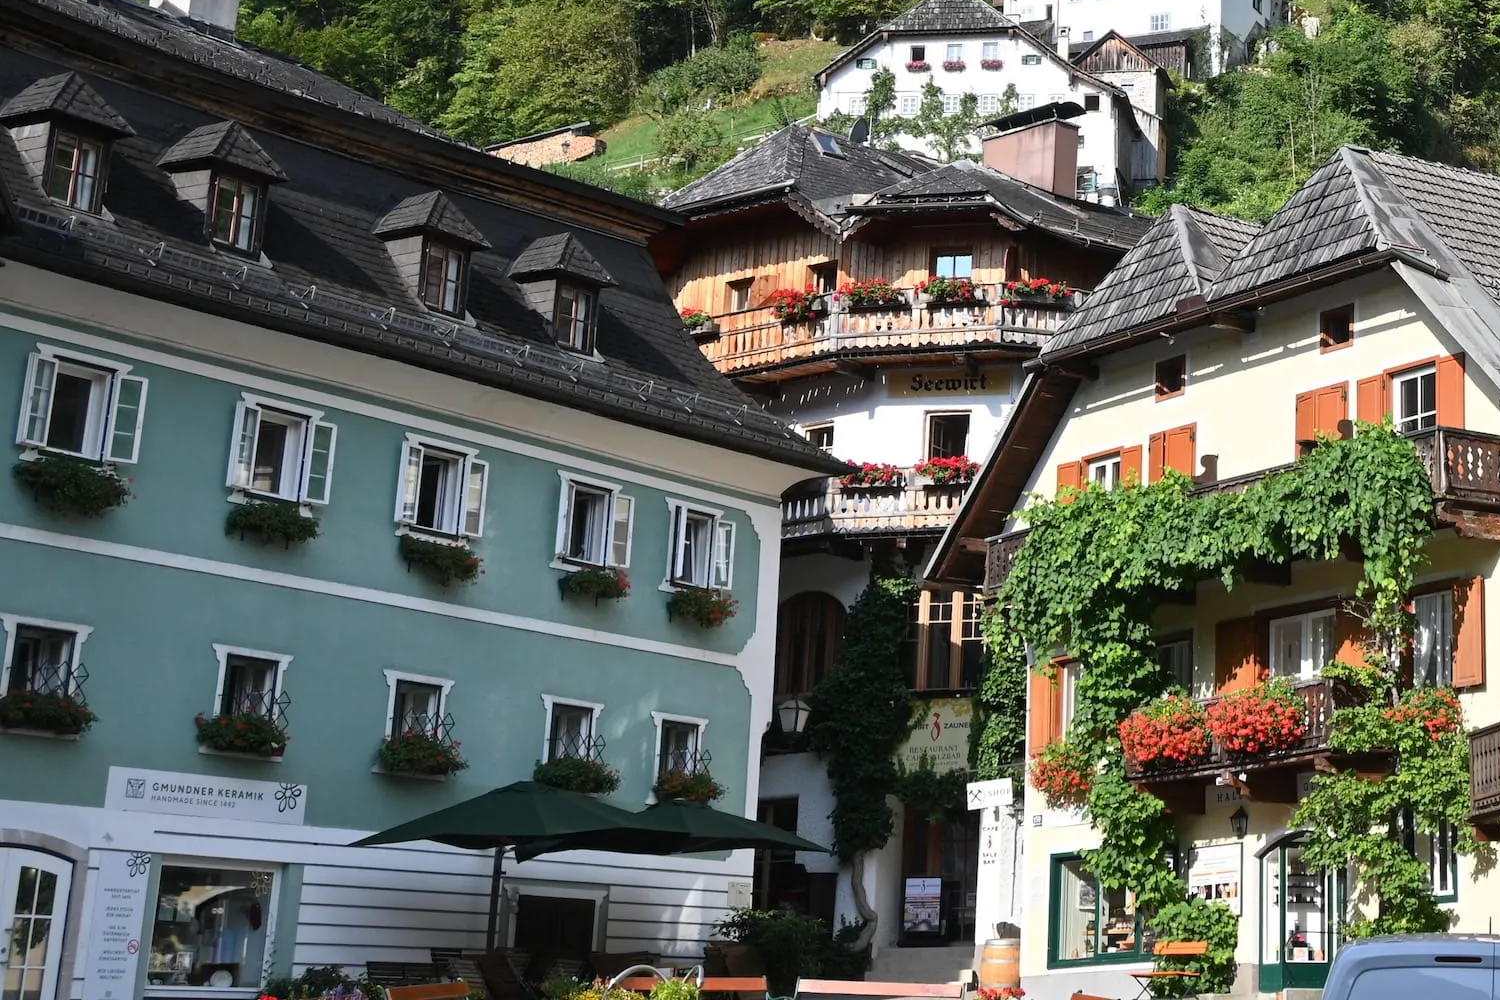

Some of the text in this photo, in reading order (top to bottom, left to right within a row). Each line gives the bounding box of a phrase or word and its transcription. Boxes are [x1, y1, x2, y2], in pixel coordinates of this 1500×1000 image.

[910, 372, 987, 392] Seewirt
[909, 745, 958, 754] RESTAURANT
[152, 782, 264, 801] GMUNDNER KERAMIK
[151, 794, 193, 805] HANDMADE
[195, 799, 218, 808] SINCE
